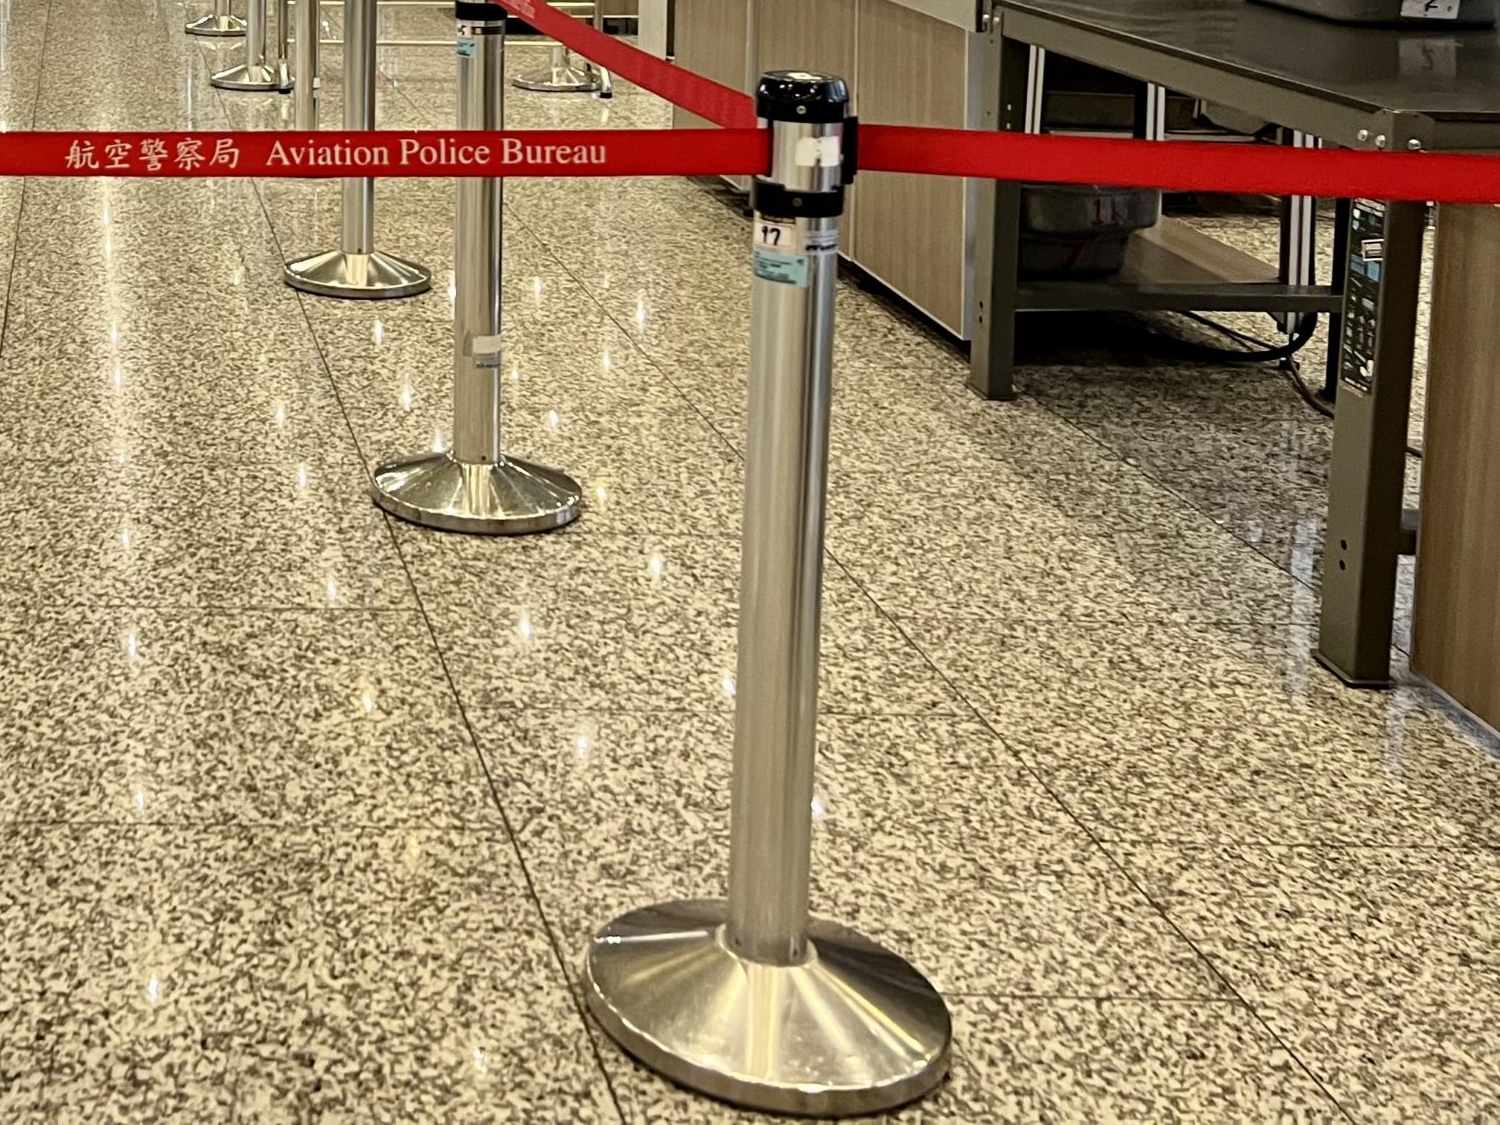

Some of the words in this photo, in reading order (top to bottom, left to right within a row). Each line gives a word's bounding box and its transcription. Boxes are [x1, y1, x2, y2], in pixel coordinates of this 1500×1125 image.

[65, 137, 240, 171] 航空警察局
[266, 139, 389, 166] Aviation
[399, 138, 490, 165] Police
[501, 138, 606, 165] Bureau
[761, 226, 781, 246] 17
